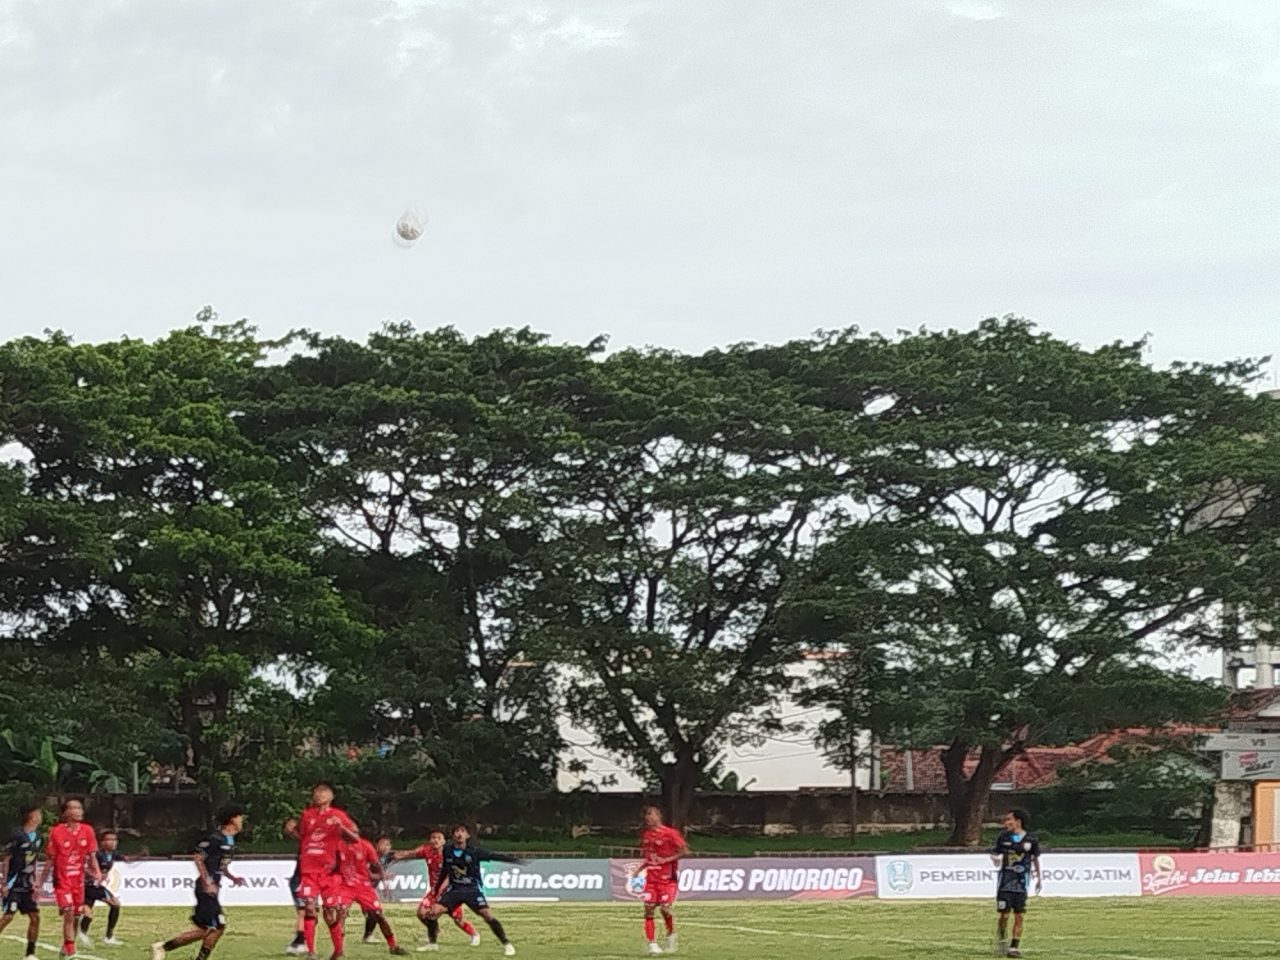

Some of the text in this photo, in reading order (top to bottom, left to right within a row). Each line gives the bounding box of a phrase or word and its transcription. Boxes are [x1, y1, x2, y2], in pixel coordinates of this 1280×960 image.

[676, 868, 864, 891] OLRES PONOROGO
[1084, 869, 1132, 881] JATIM
[1189, 868, 1240, 884] Jelas
[124, 876, 166, 889] KONI
